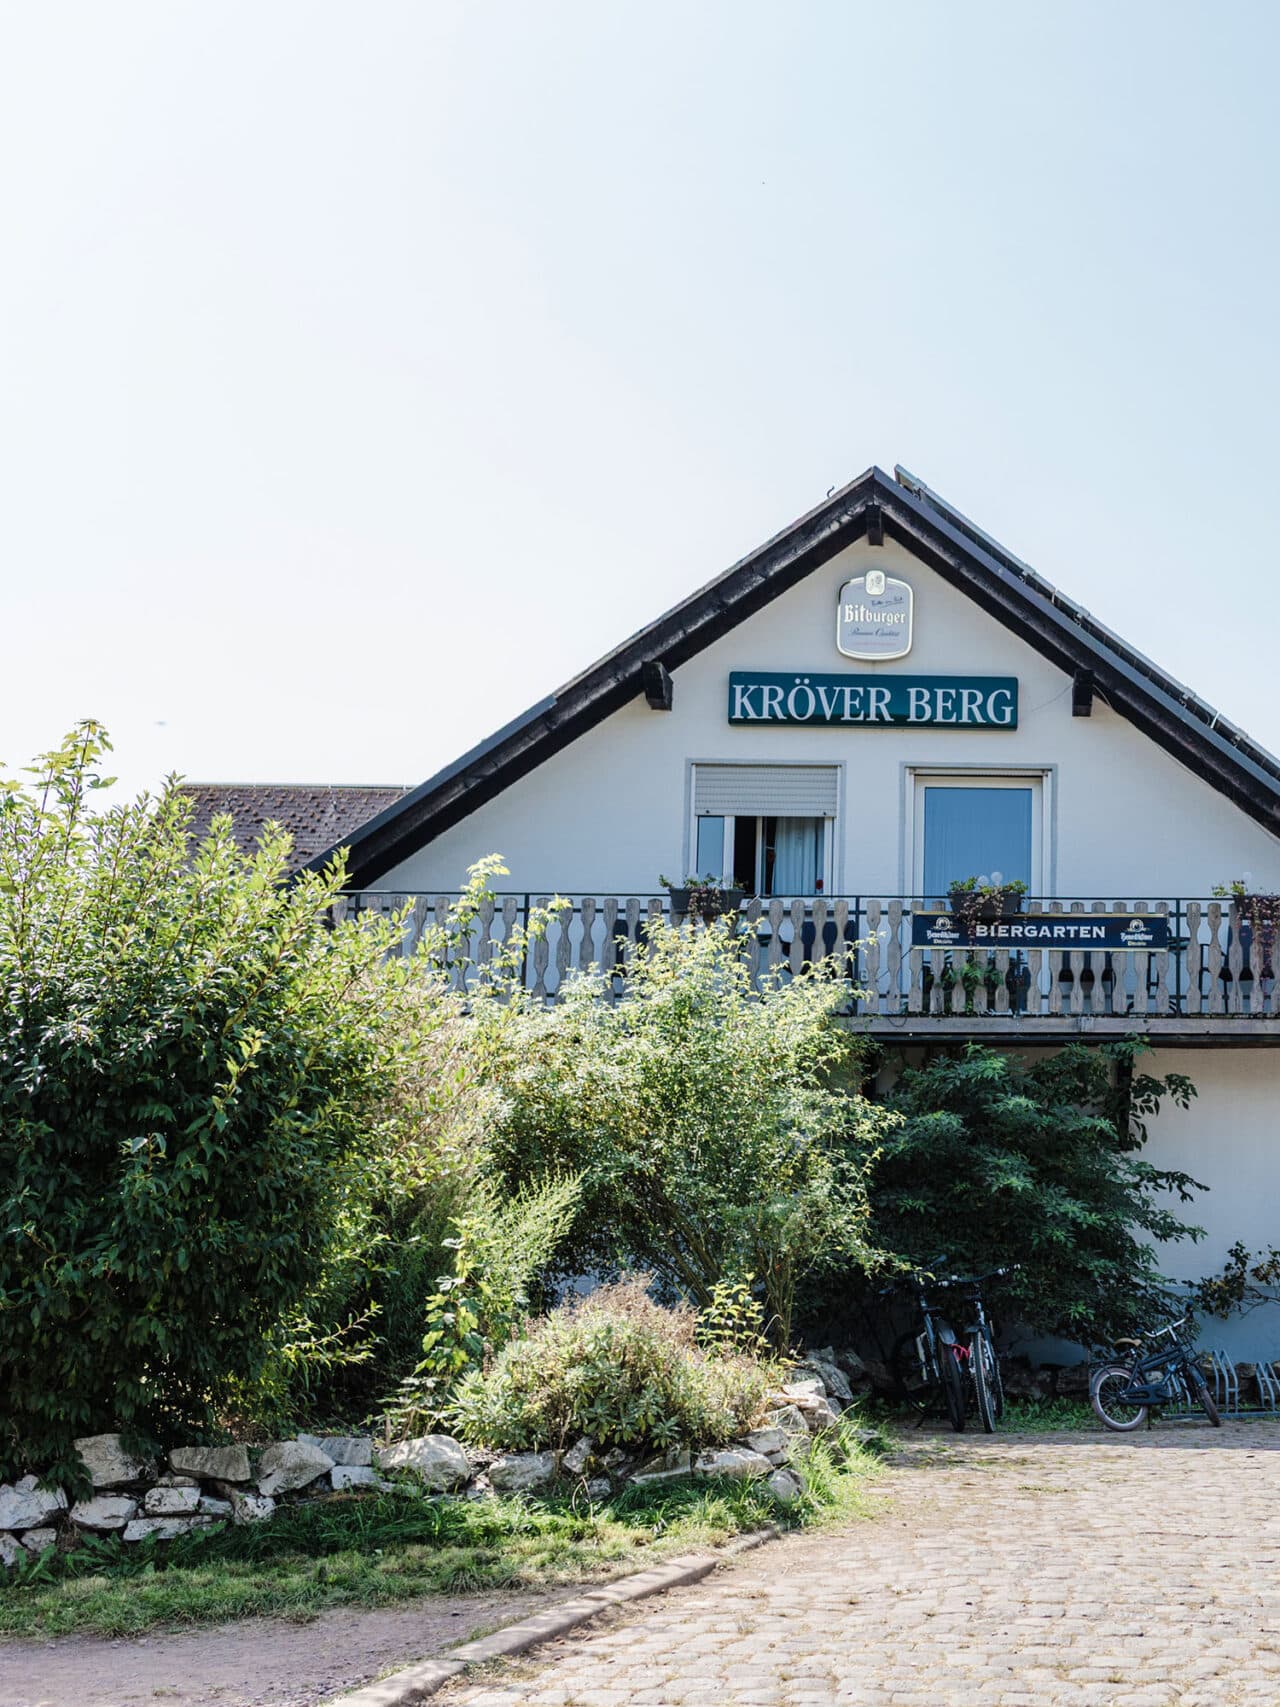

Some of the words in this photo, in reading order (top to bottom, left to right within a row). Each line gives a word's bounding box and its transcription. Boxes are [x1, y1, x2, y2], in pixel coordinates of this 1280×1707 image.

[844, 603, 906, 626] Bitburger
[731, 677, 895, 722] KRÖVER
[906, 687, 1014, 724] BERG
[975, 924, 1106, 939] BIERGARTEN
